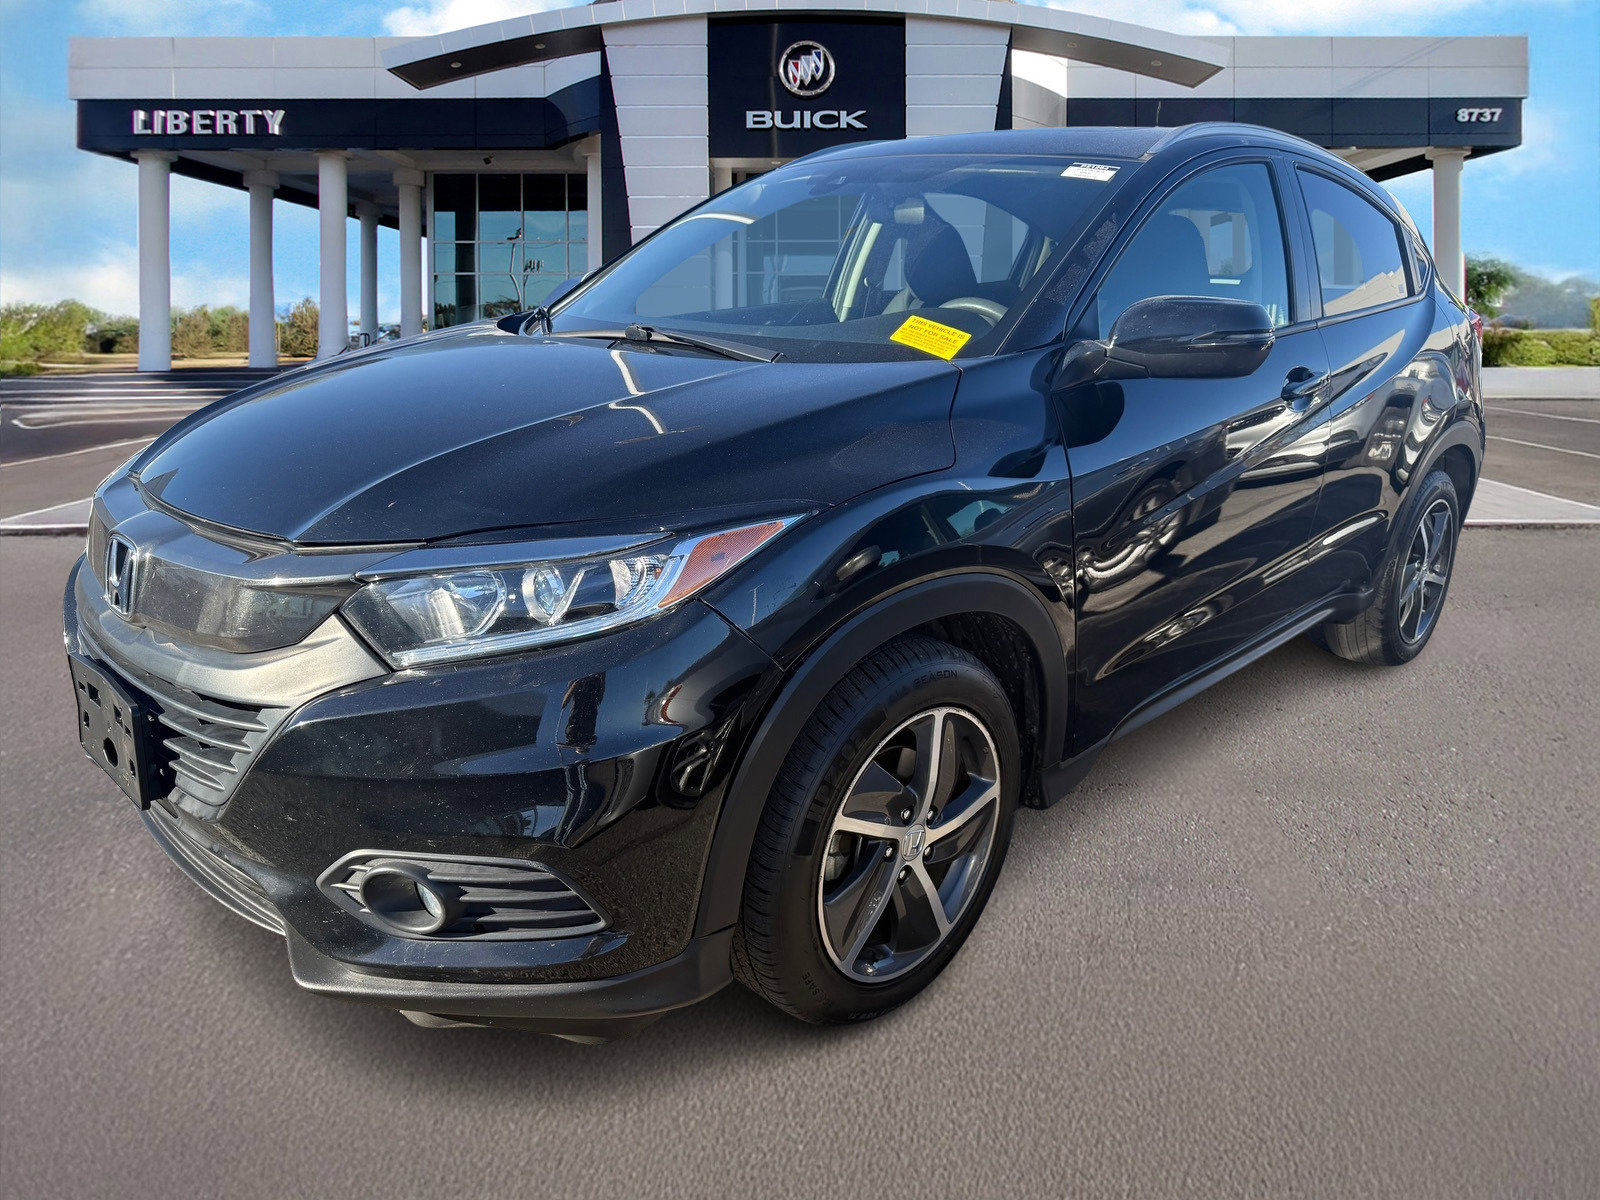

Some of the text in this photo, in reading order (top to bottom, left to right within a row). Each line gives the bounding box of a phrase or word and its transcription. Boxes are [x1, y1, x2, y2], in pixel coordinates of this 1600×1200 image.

[132, 109, 285, 135] LIBERTY
[746, 110, 868, 129] BUICK
[1456, 108, 1503, 122] 8737
[908, 324, 958, 344] NOT FOR SALE
[911, 318, 928, 327] THIS
[928, 323, 957, 336] VEHICLE
[913, 669, 958, 688] SEASON
